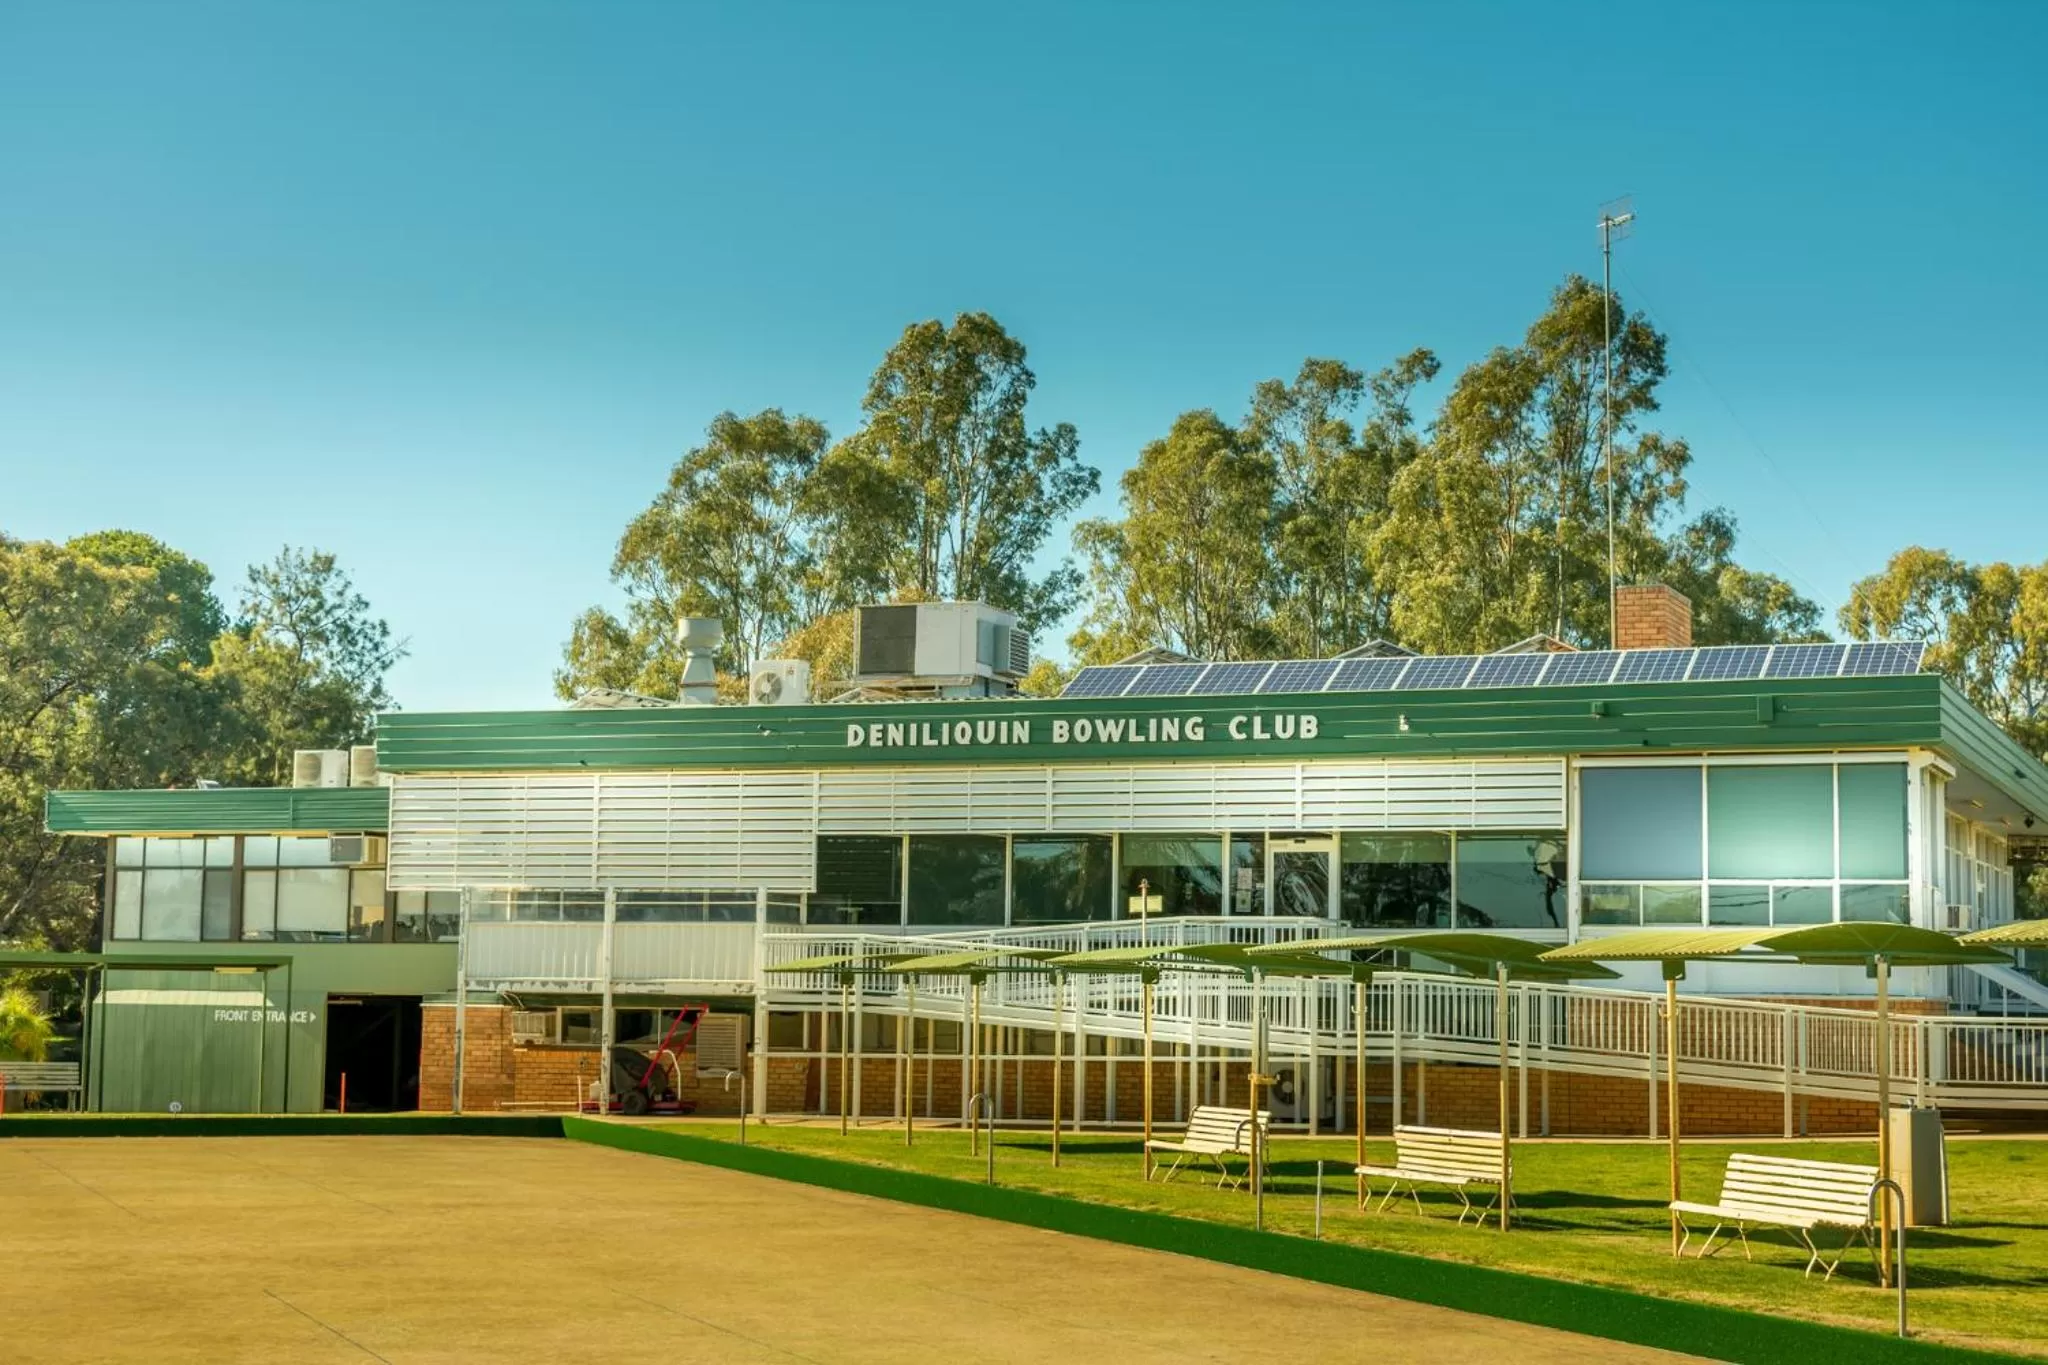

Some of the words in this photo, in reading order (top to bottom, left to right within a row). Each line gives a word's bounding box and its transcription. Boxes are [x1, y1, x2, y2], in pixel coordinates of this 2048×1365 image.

[848, 720, 1030, 747] DENILIQUIN
[1052, 717, 1205, 743] BOWLING
[1228, 715, 1319, 740] CLUB
[214, 1009, 249, 1022] FRONT
